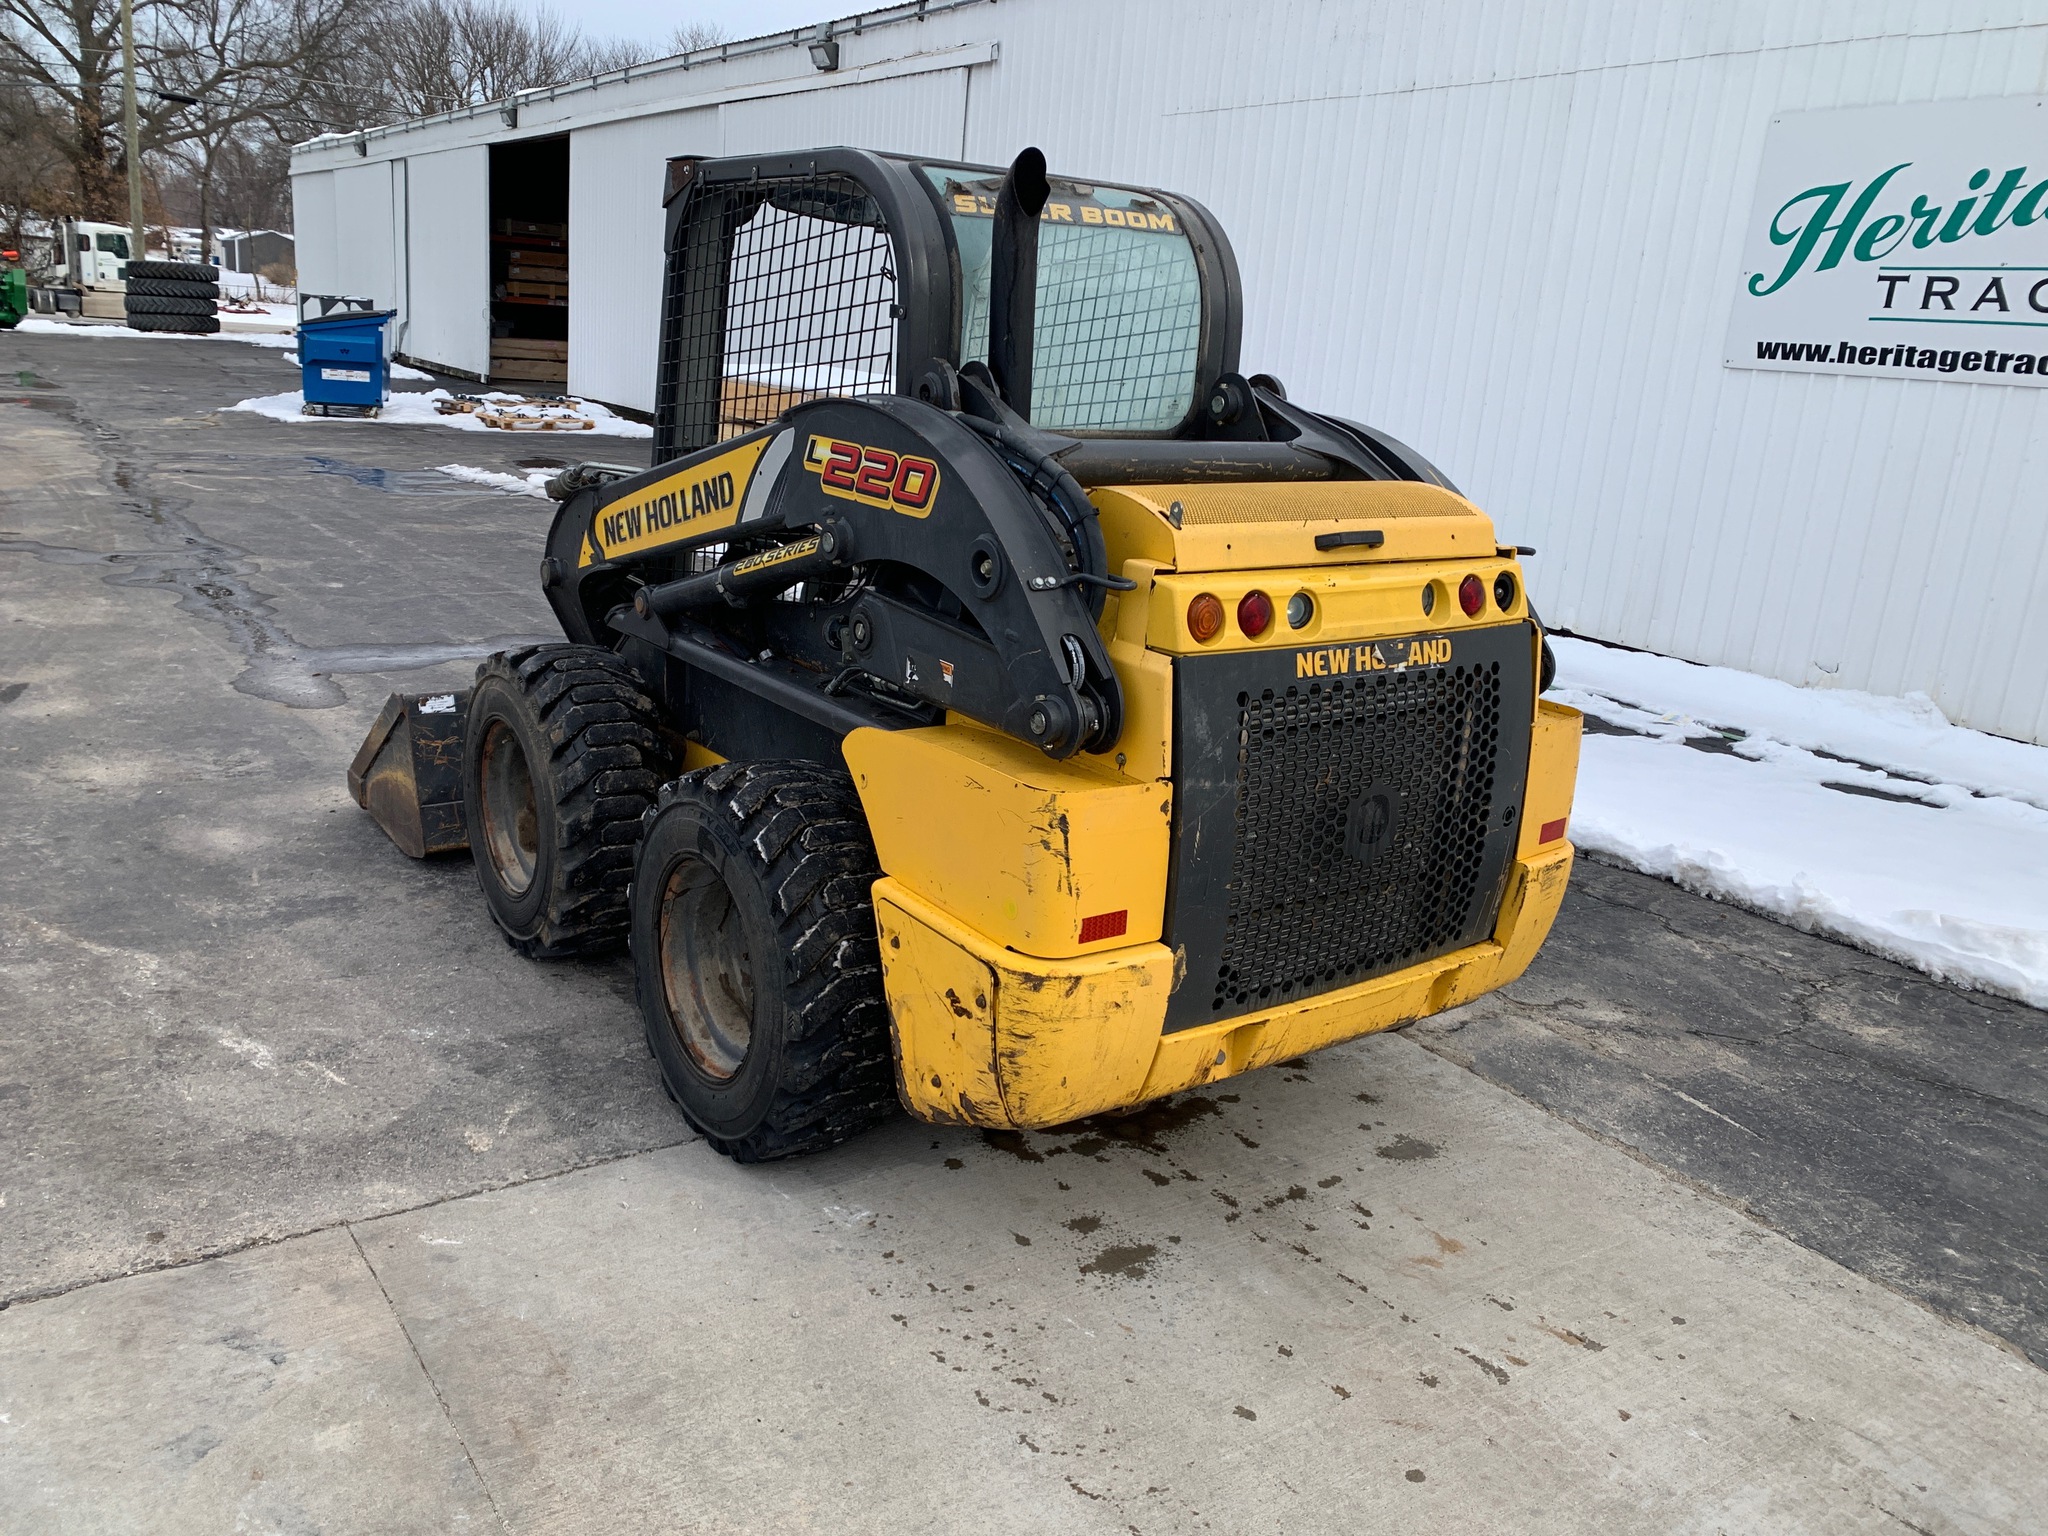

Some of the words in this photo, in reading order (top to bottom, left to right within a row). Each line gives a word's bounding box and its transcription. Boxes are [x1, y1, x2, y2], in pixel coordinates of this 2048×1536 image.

[953, 193, 1074, 223] SUR
[1079, 205, 1175, 232] BOOM
[804, 436, 940, 512] L220
[603, 504, 642, 548] NEW
[644, 471, 734, 534] HOLLAND
[765, 537, 820, 564] SERIES
[1296, 648, 1350, 679] NEW
[1355, 638, 1452, 673] HAND
